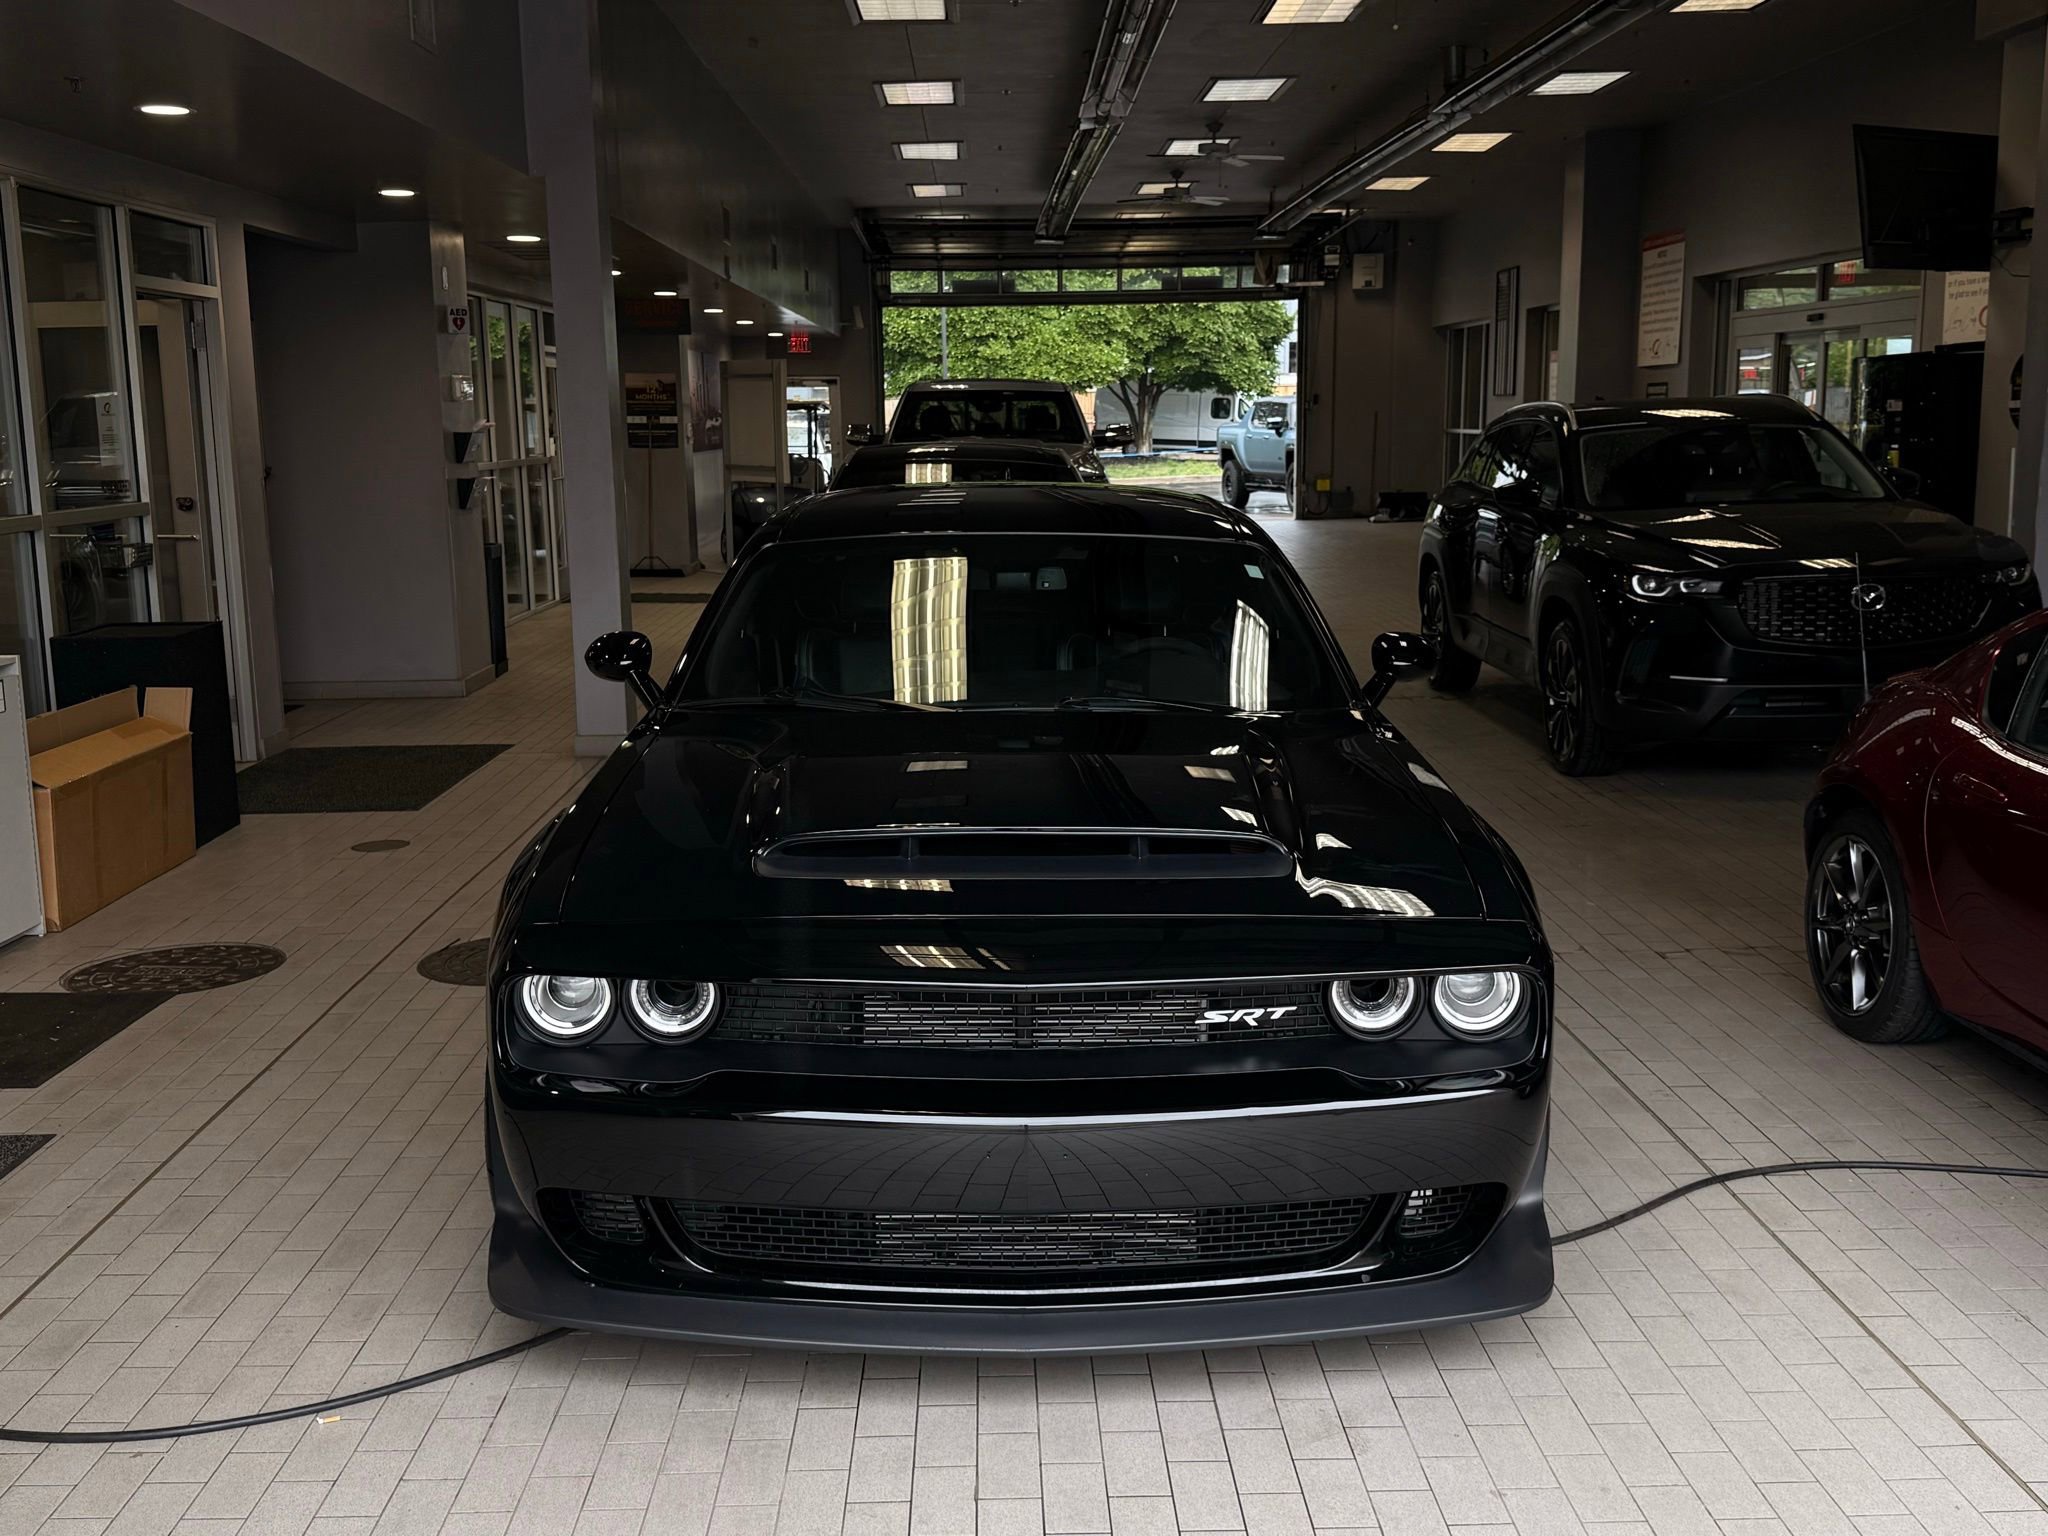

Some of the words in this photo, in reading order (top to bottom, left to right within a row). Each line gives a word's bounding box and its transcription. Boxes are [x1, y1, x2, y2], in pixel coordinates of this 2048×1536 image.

[449, 308, 468, 316] AED
[790, 337, 809, 351] EXIT
[1194, 1006, 1298, 1027] SRT
